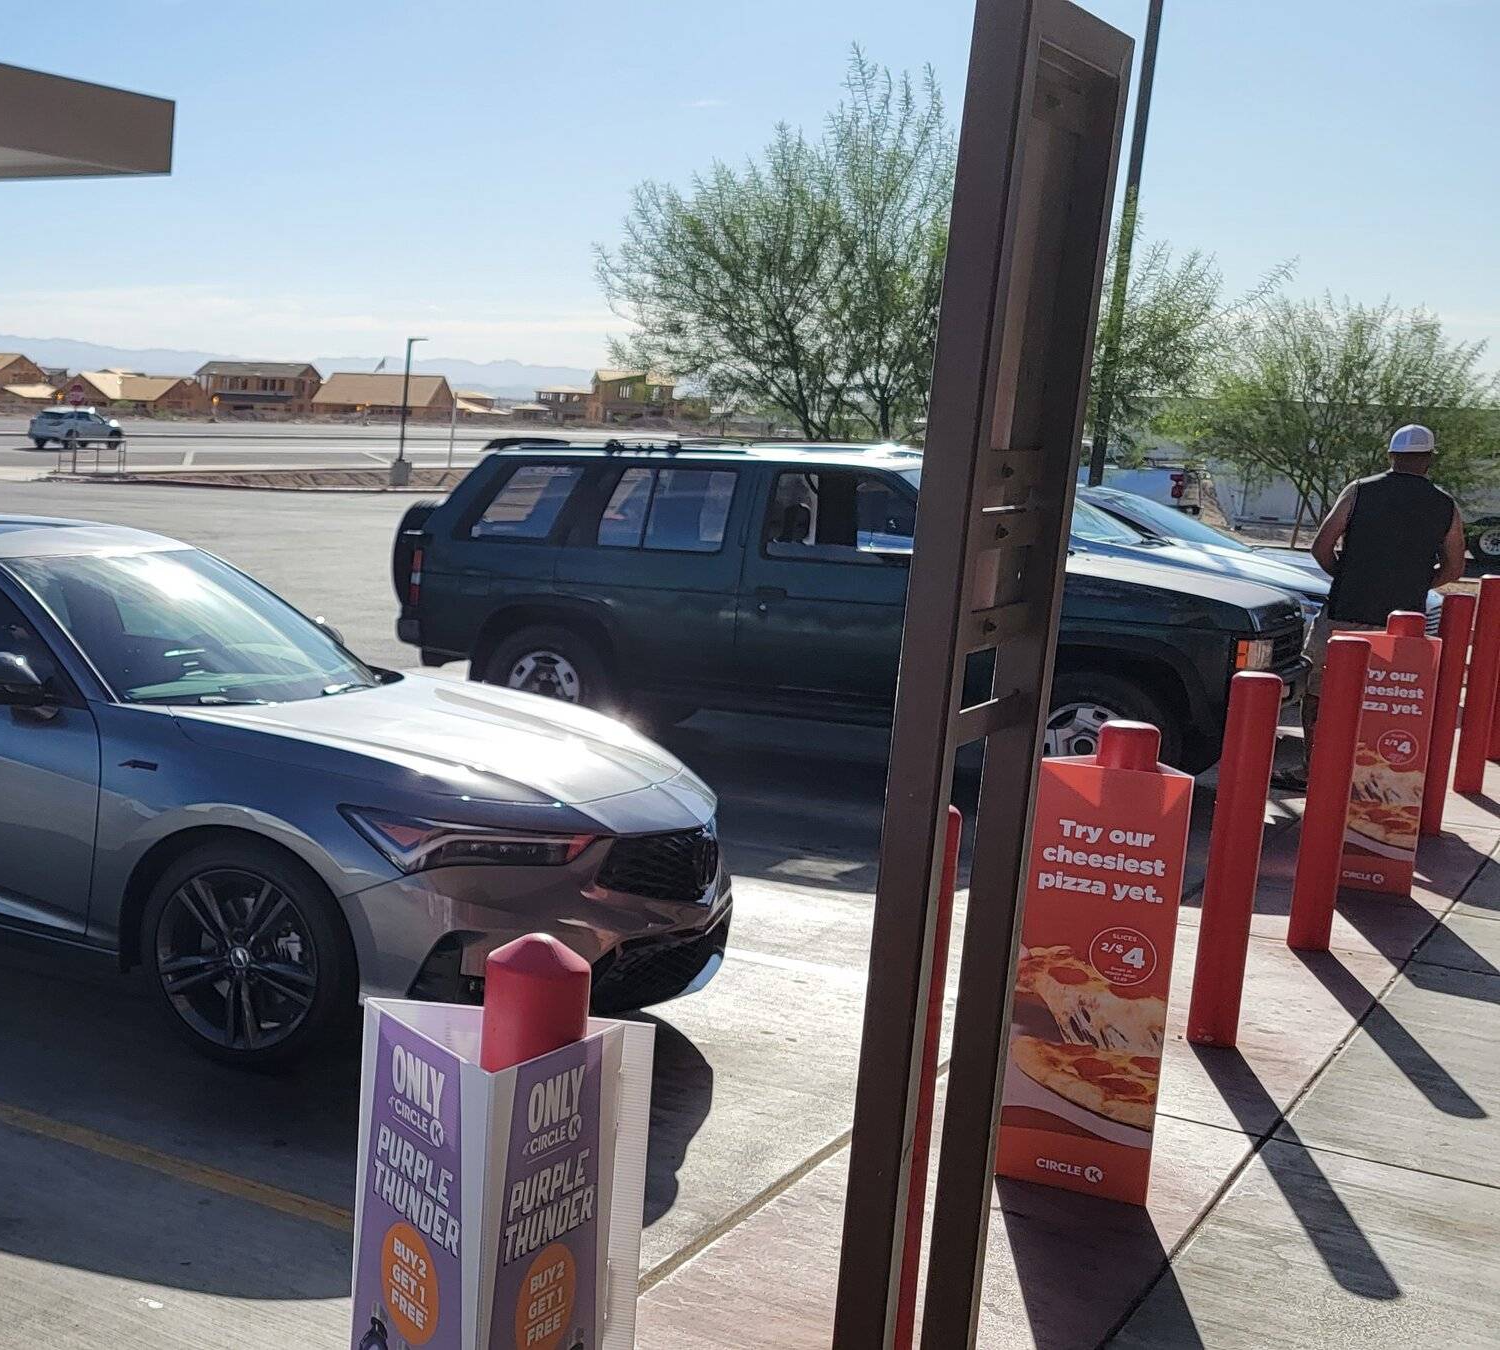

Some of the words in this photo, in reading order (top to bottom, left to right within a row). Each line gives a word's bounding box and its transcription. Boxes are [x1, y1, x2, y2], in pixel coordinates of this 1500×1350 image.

[1389, 672, 1418, 683] our
[1391, 703, 1422, 716] yet.
[1059, 819, 1103, 844] Try
[1109, 829, 1155, 848] our
[1042, 845, 1166, 877] cheesiest
[1038, 871, 1106, 895] pizza
[1112, 883, 1163, 904] yet.
[1112, 933, 1137, 943] SLICES
[392, 1044, 445, 1120] ONLY
[528, 1063, 587, 1134] ONLY
[394, 1098, 429, 1133] CIRCLE
[430, 1118, 444, 1148] K
[529, 1125, 567, 1155] CIRCLE
[568, 1113, 582, 1141] K
[376, 1123, 453, 1208] PURPLE
[507, 1148, 590, 1223] PURPLE
[1035, 1157, 1082, 1176] CIRCLE
[1084, 1165, 1103, 1184] K
[373, 1158, 461, 1257] THUNDER
[503, 1184, 596, 1266] THUNDER
[393, 1237, 418, 1270] BUY
[418, 1258, 427, 1279] 2
[530, 1264, 556, 1295] BUY
[556, 1260, 565, 1280] 2
[392, 1264, 418, 1296] GET
[419, 1285, 426, 1304] 1
[528, 1289, 556, 1320] GET
